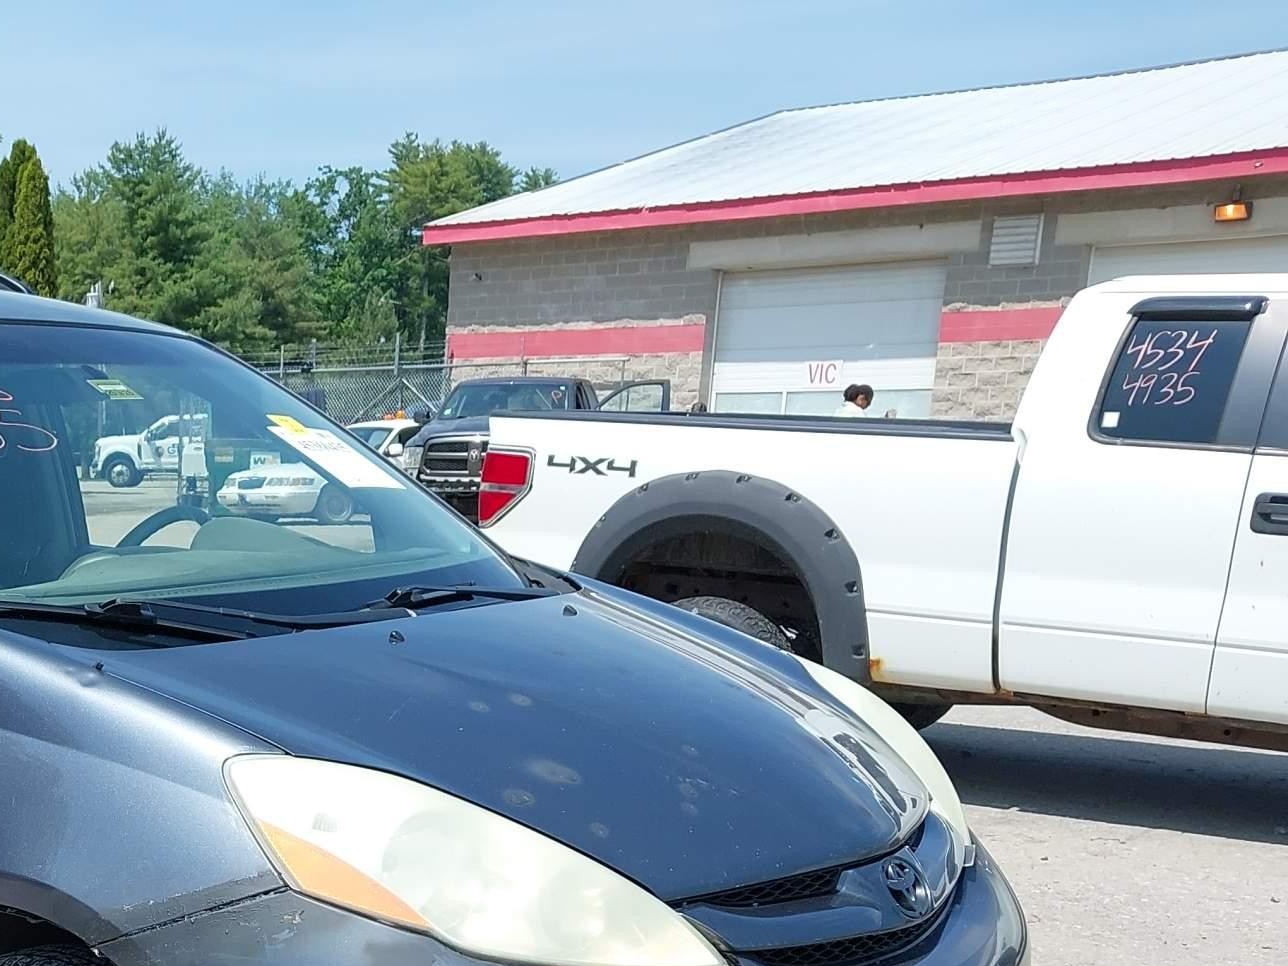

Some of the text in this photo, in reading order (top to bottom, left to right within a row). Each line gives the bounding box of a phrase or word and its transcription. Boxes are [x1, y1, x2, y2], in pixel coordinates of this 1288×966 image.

[1126, 328, 1218, 372] 4534
[808, 363, 838, 384] VIC
[1122, 371, 1201, 406] 4935
[546, 454, 638, 479] 4X4
